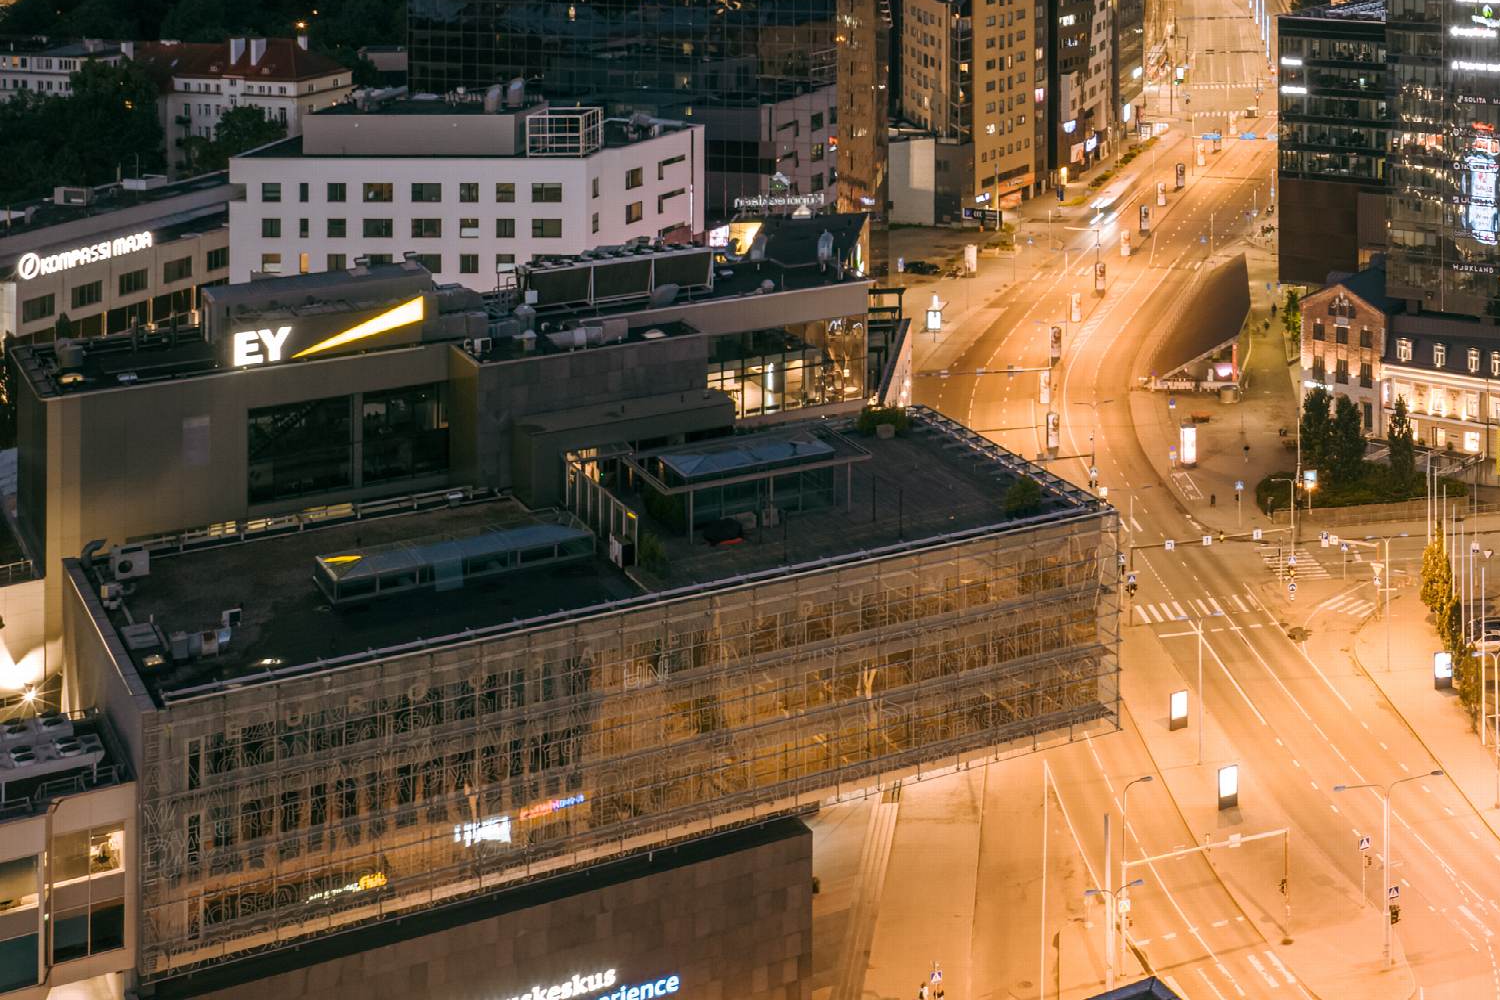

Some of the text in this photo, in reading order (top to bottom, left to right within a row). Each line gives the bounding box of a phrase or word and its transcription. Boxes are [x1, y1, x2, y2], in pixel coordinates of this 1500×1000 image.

[1464, 96, 1487, 105] SOLITA
[40, 230, 152, 275] KOMPASSI MAJA
[234, 326, 292, 367] EY
